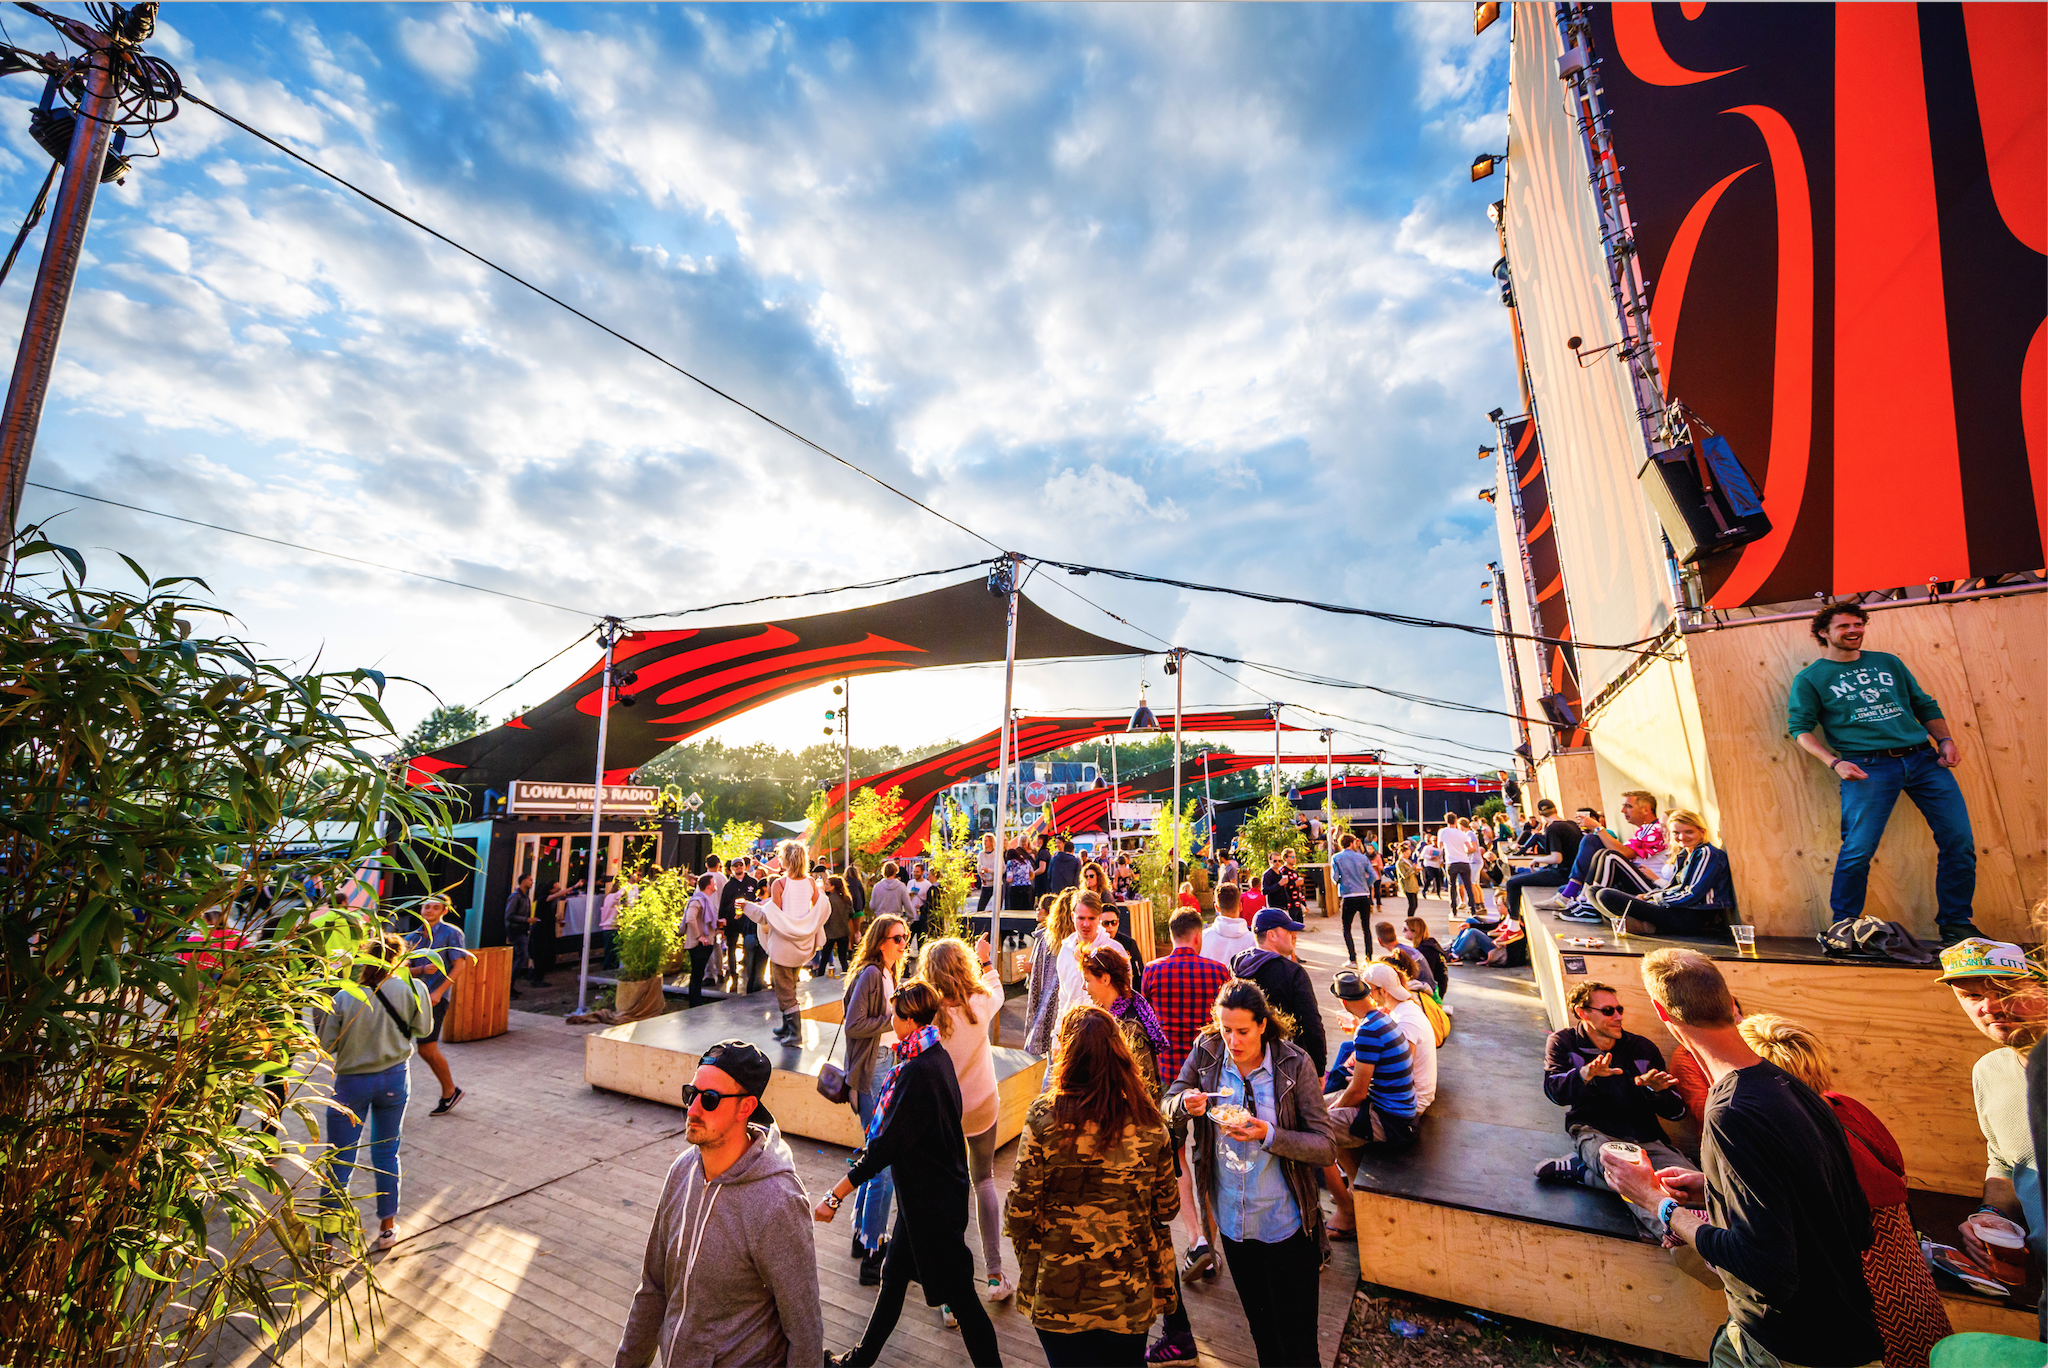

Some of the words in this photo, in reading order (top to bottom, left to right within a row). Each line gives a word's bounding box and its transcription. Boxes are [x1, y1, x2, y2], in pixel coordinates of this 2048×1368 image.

[1839, 667, 1878, 679] ALUMI
[520, 785, 608, 800] LOWLANDS
[611, 788, 654, 802] RADIO
[1951, 957, 1996, 969] ATLANTIC
[2000, 957, 2024, 969] CITY
